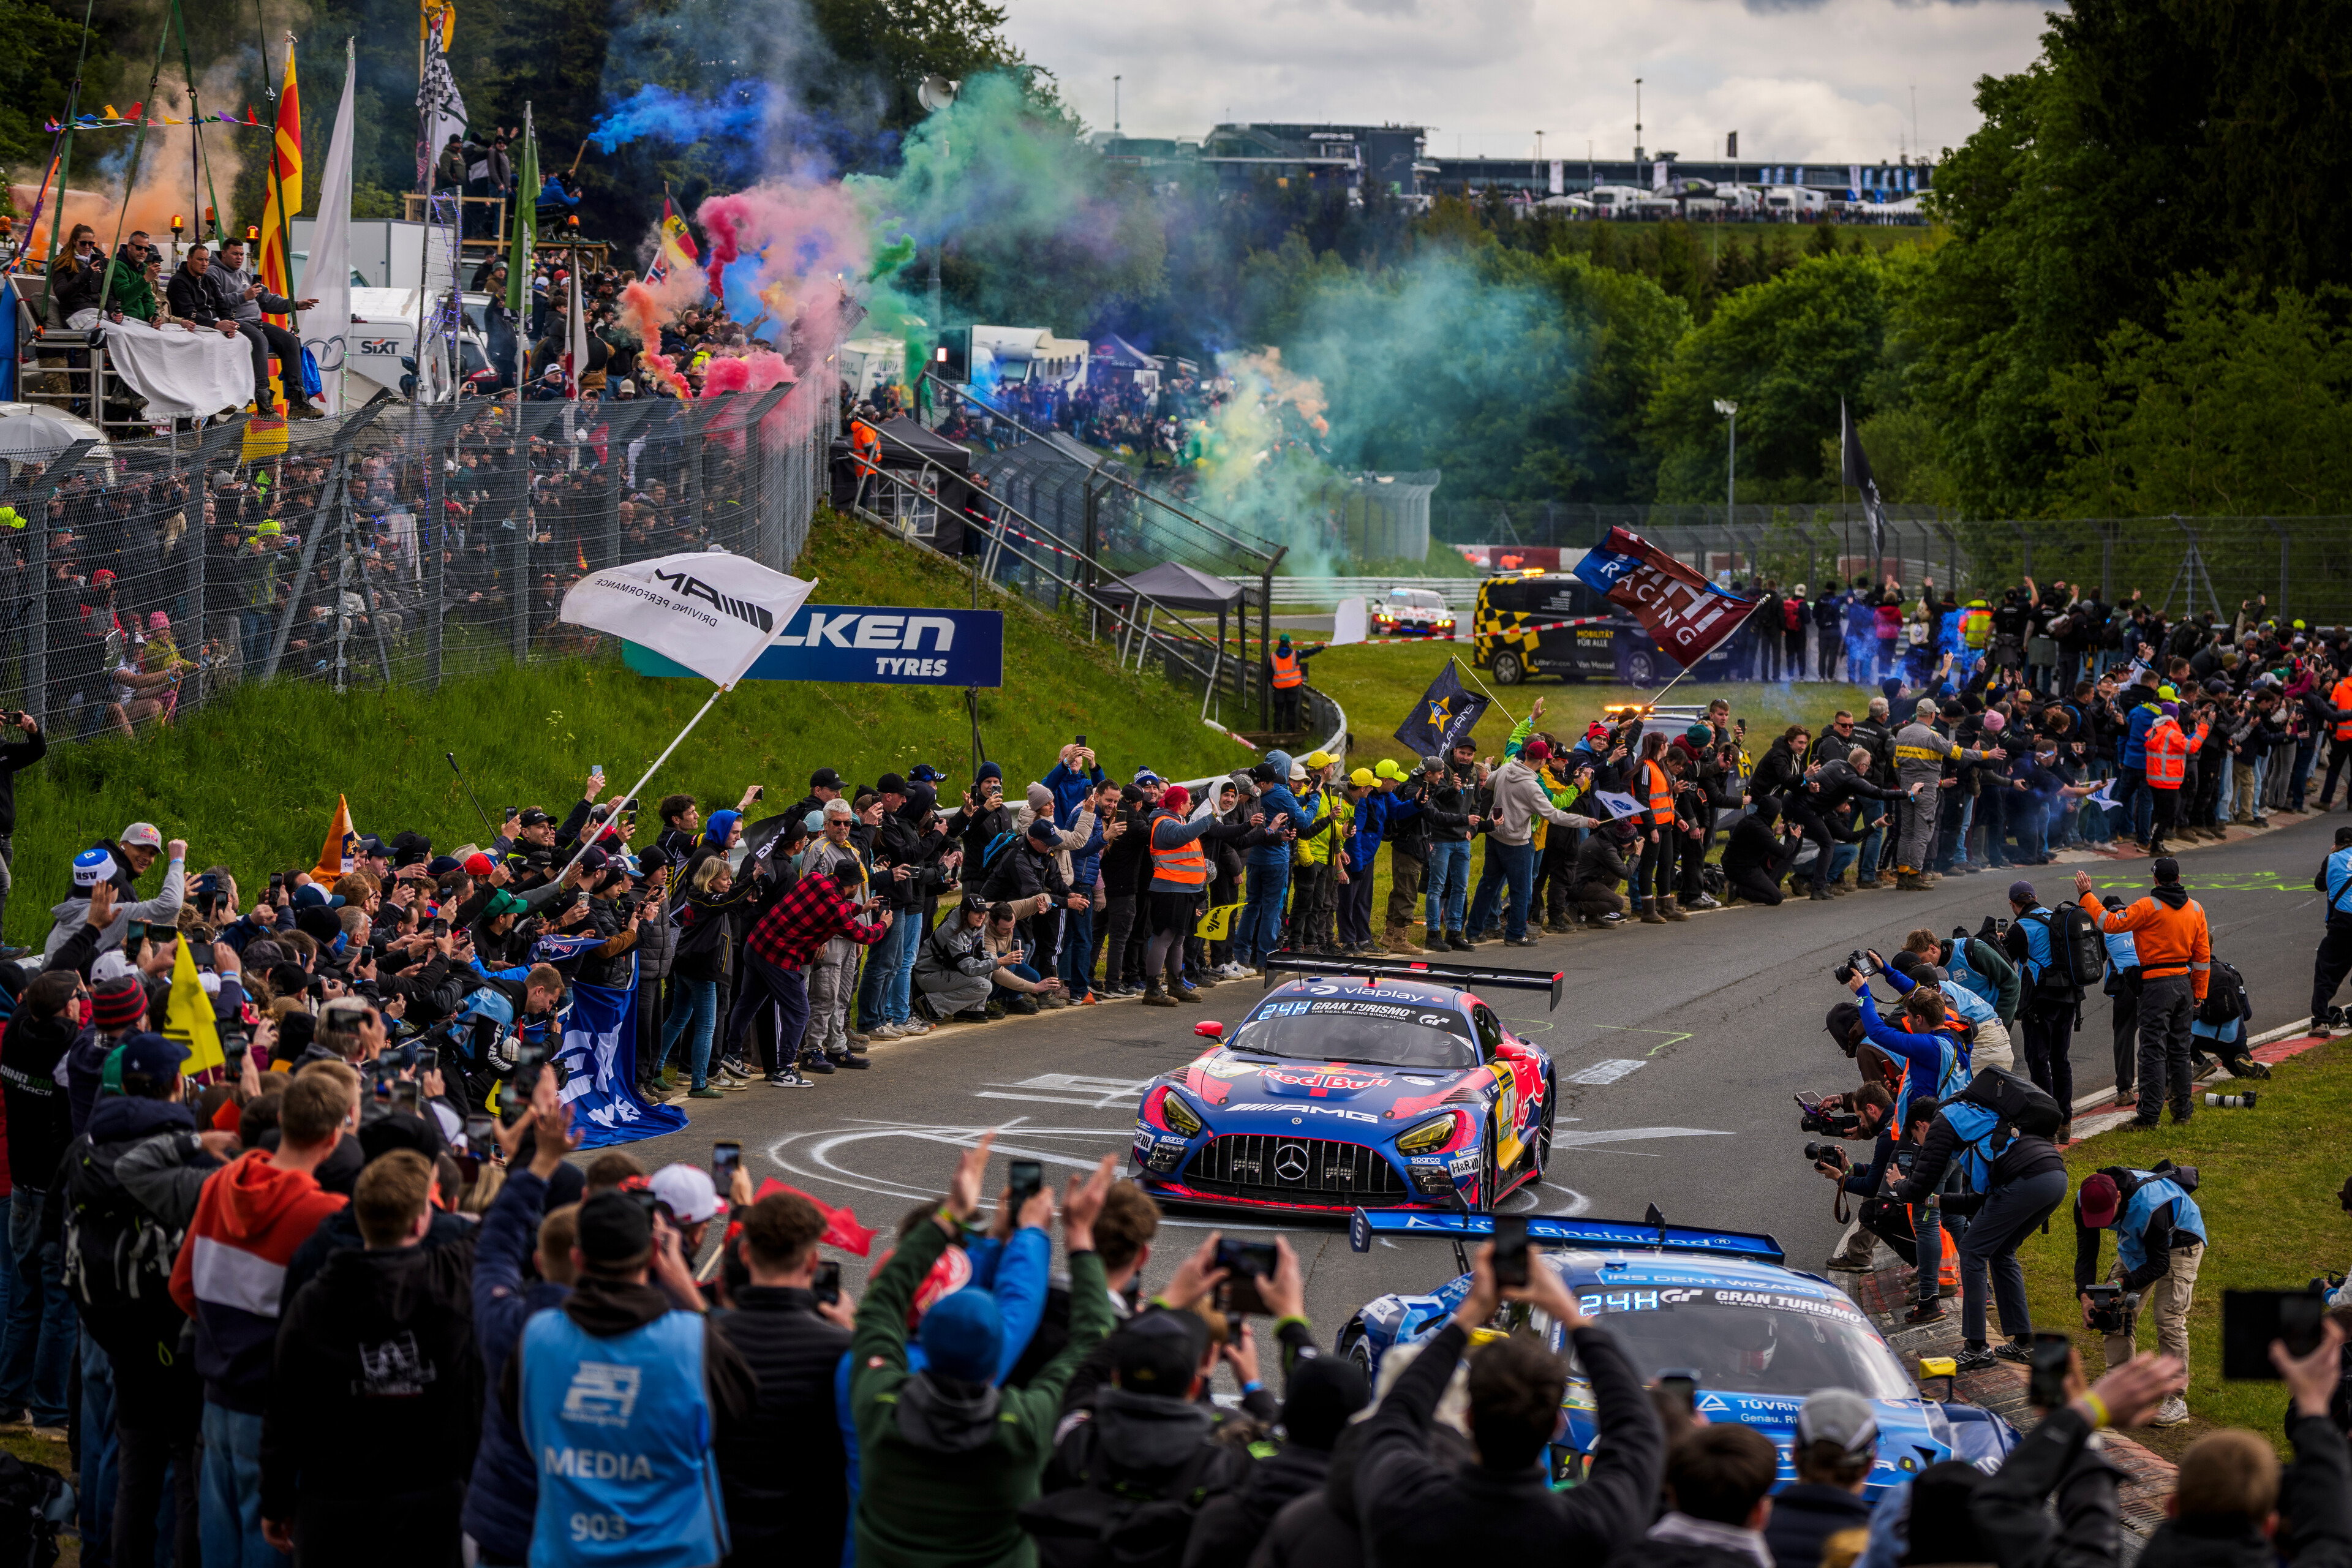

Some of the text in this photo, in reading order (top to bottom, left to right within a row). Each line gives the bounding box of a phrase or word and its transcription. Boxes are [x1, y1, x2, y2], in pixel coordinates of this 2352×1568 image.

[361, 338, 399, 354] SIXT
[1600, 560, 1697, 646] RACING
[771, 613, 955, 651] KEN
[876, 657, 948, 677] TYRES
[1344, 987, 1425, 1002] viaplay
[1311, 1001, 1348, 1011] GRAN
[1256, 1069, 1324, 1087] Red
[1324, 1077, 1392, 1089] Bull
[1272, 1104, 1378, 1124] AMG
[1161, 1135, 1185, 1144] sparco
[1452, 1160, 1471, 1175] H&R
[1654, 1276, 1722, 1284] DENT
[1725, 1280, 1817, 1294] WIZARD
[1578, 1291, 1659, 1316] 24H
[1715, 1291, 1862, 1323] GRAN TURISMO
[1740, 1414, 1782, 1423] Genau.
[545, 1446, 653, 1480] MEDIA
[570, 1512, 627, 1542] 903
